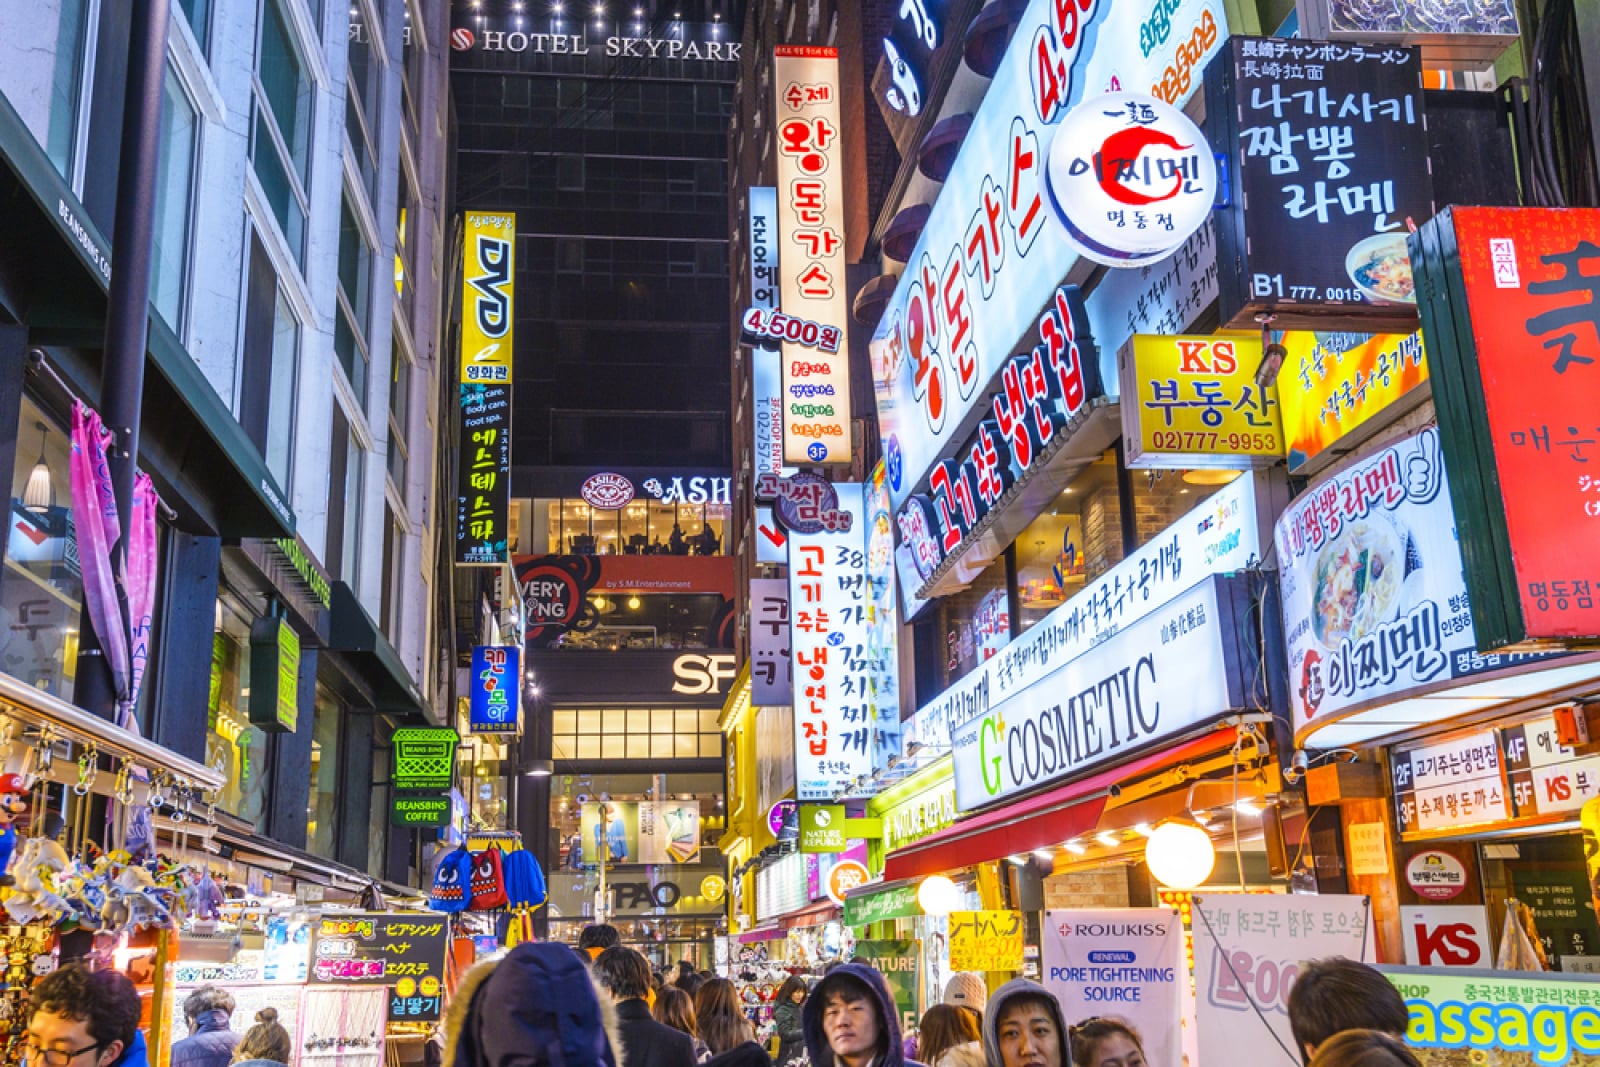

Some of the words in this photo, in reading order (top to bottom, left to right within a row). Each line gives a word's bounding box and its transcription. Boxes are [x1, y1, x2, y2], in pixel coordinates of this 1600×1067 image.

[482, 31, 590, 55] HOTEL
[605, 36, 743, 62] SKYPARK
[1241, 39, 1411, 64] 長崎チャンポンラーメン
[1037, 0, 1094, 121] 4,5
[786, 85, 830, 109] 수제
[1250, 83, 1417, 125] 나가사키
[1239, 120, 1357, 181] 짬뽕
[781, 119, 840, 295] 왕돈가스
[1280, 179, 1403, 233] 라멘
[1107, 209, 1176, 232] 명동점
[752, 215, 779, 308] 준오헤어
[466, 232, 512, 339] DVD
[905, 134, 1043, 422] 왕돈가스
[1252, 272, 1286, 298] B1
[747, 309, 840, 351] 4,500원
[1178, 340, 1238, 374] KS
[466, 365, 508, 380] 영화관
[1145, 380, 1276, 427] 부동산
[809, 446, 827, 459] 3F
[1152, 431, 1276, 450] 02)777-9953
[618, 578, 692, 588] S.M.Entertainment
[1529, 580, 1593, 611] 명동점
[1327, 602, 1444, 697] 이찌멘
[1007, 652, 1161, 787] COSMETIC
[1415, 743, 1499, 778] 고기주는냉면집
[1507, 737, 1526, 763] 4F
[1396, 762, 1412, 786] 2F
[1514, 780, 1533, 807] 5F
[1545, 775, 1573, 803] KS
[1401, 801, 1416, 825] 3F
[1420, 787, 1504, 819] 수제왕돈까스
[405, 811, 440, 822] COFFEE
[805, 829, 842, 838] NATURE
[1074, 923, 1167, 937] ROJUKISS
[386, 943, 412, 955] ヘナ
[1091, 952, 1132, 962] RENEWAL
[1413, 922, 1482, 967] KS
[385, 963, 430, 976] エクステ
[866, 956, 916, 972] ATURE
[1050, 967, 1088, 982] PORE
[1089, 967, 1175, 983] TIGHTENING
[1083, 986, 1142, 1002] SOURCE
[1396, 984, 1431, 999] HOP
[1406, 1003, 1600, 1062] assage
